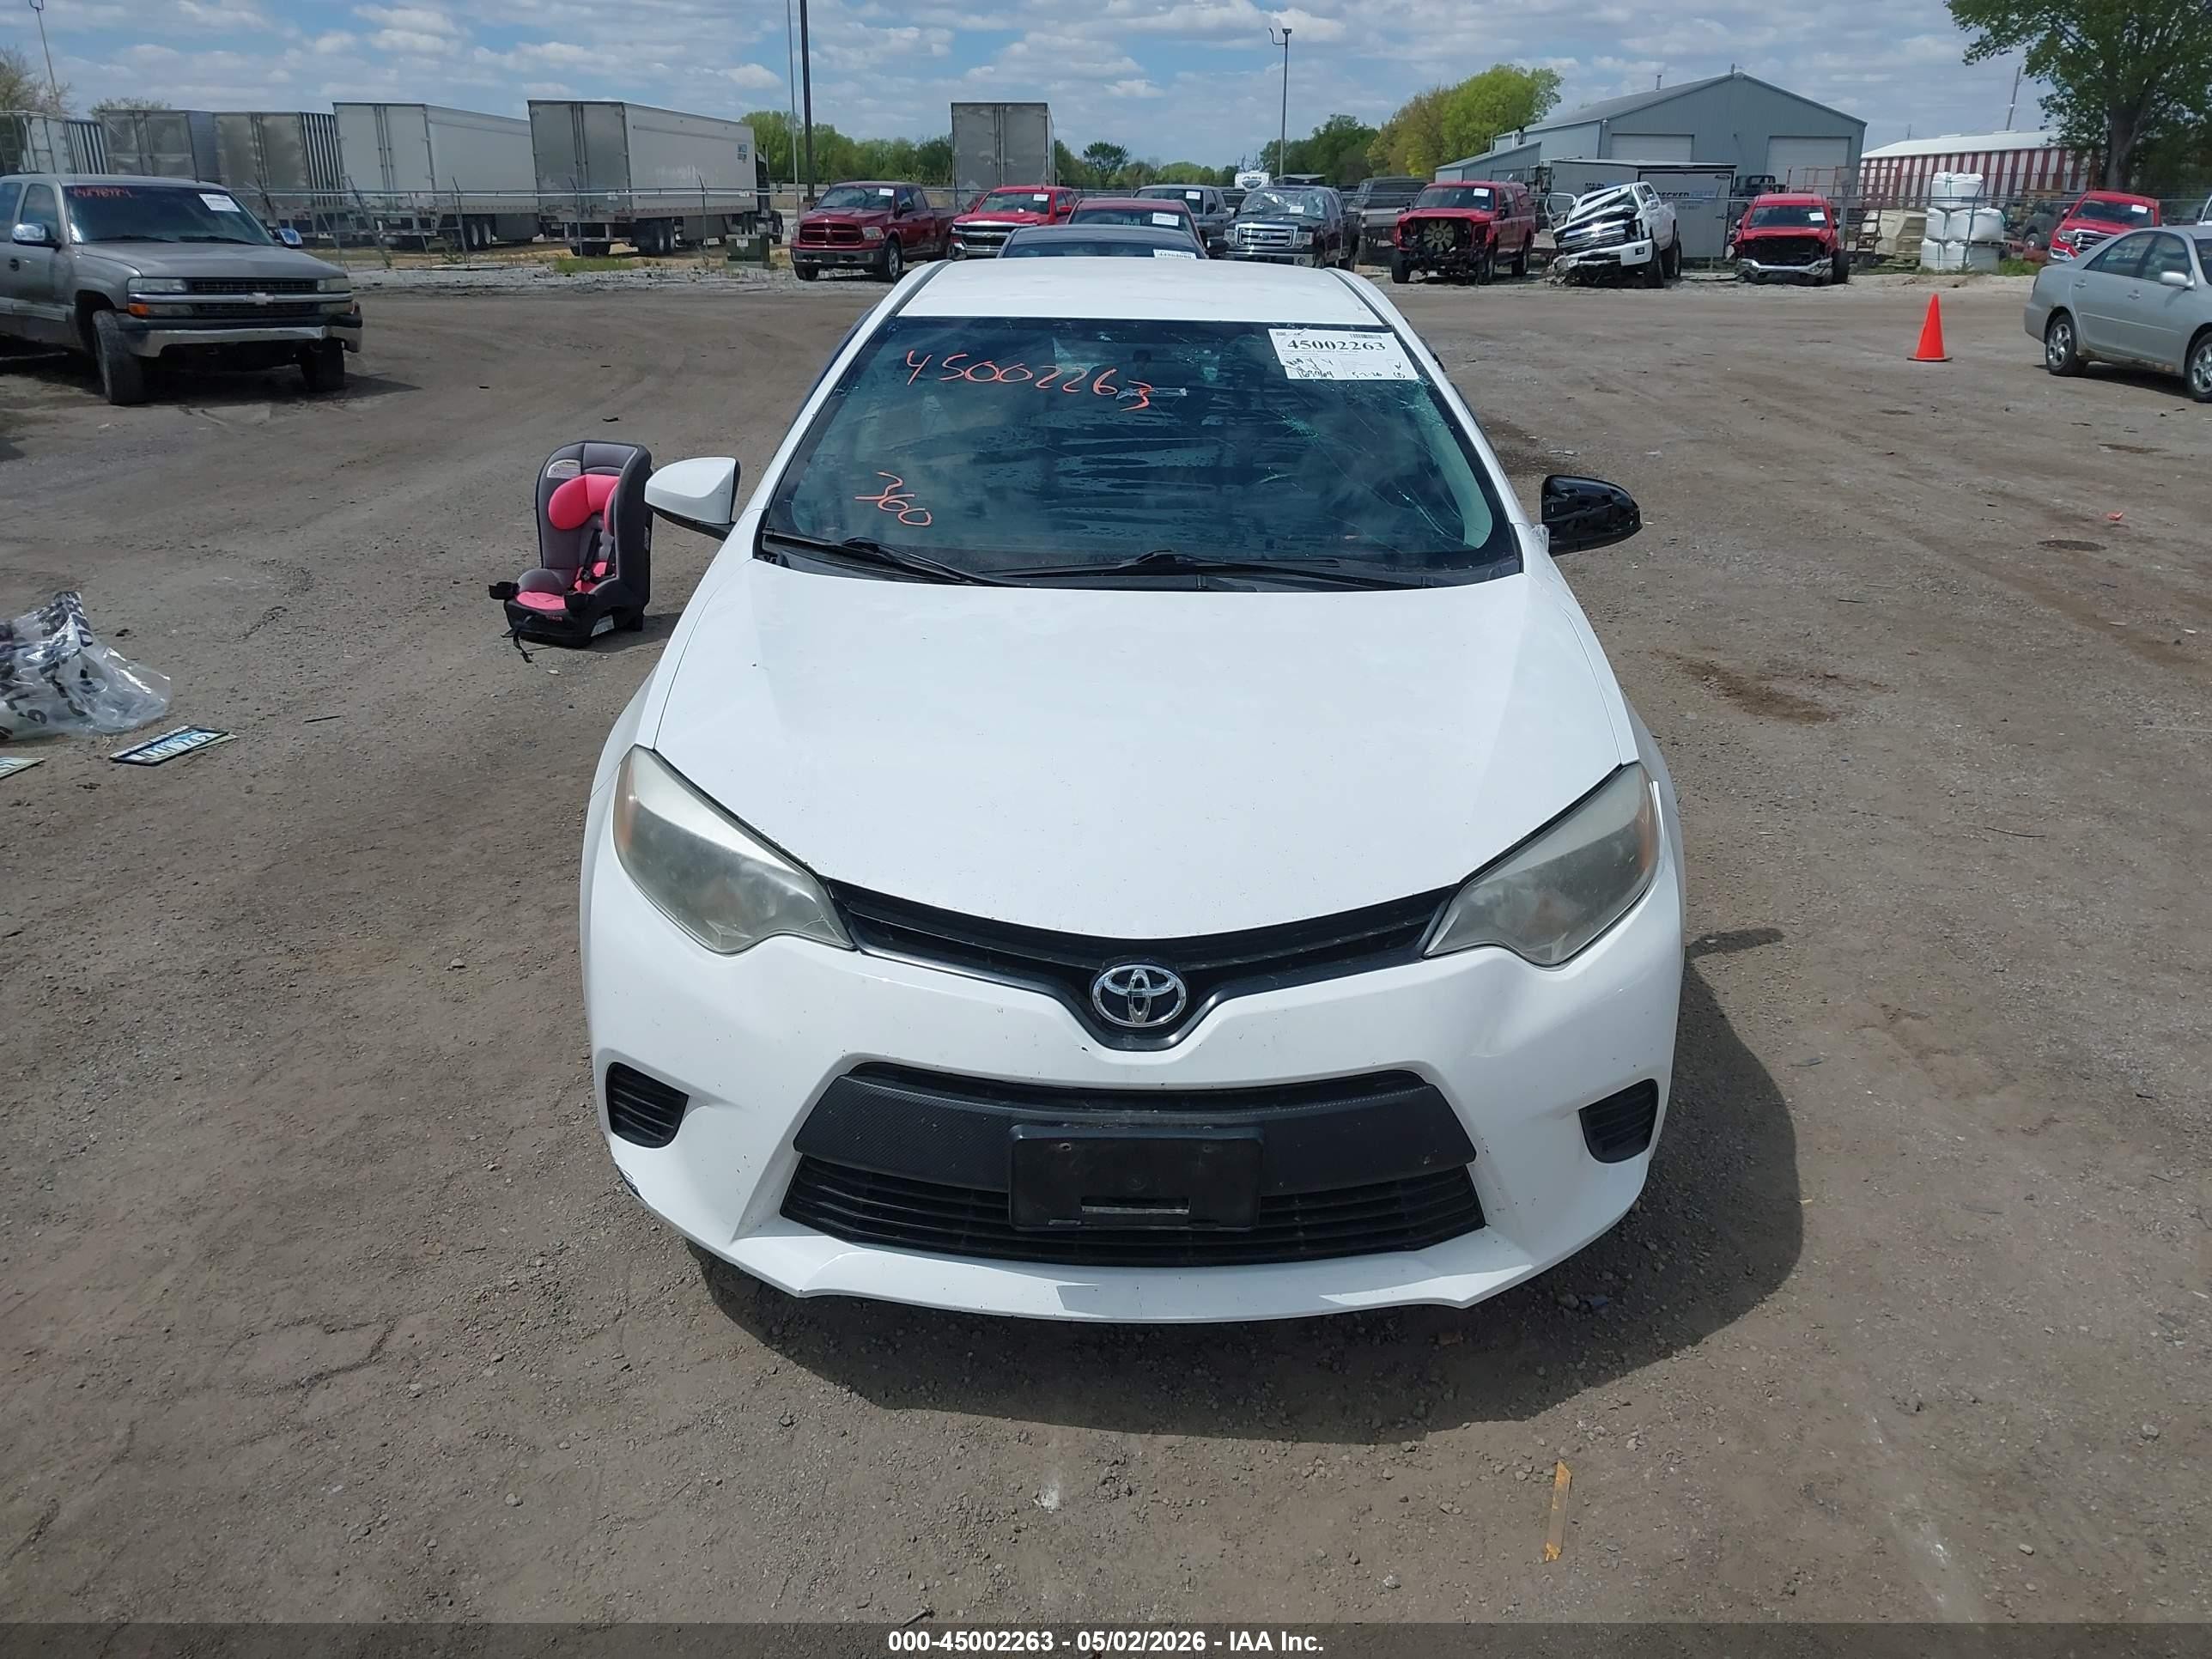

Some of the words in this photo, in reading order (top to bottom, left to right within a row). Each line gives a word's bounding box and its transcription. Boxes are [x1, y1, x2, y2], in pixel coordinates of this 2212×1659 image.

[1287, 339, 1386, 351] 45002263
[906, 349, 1152, 411] 45002263
[854, 471, 933, 526] 360
